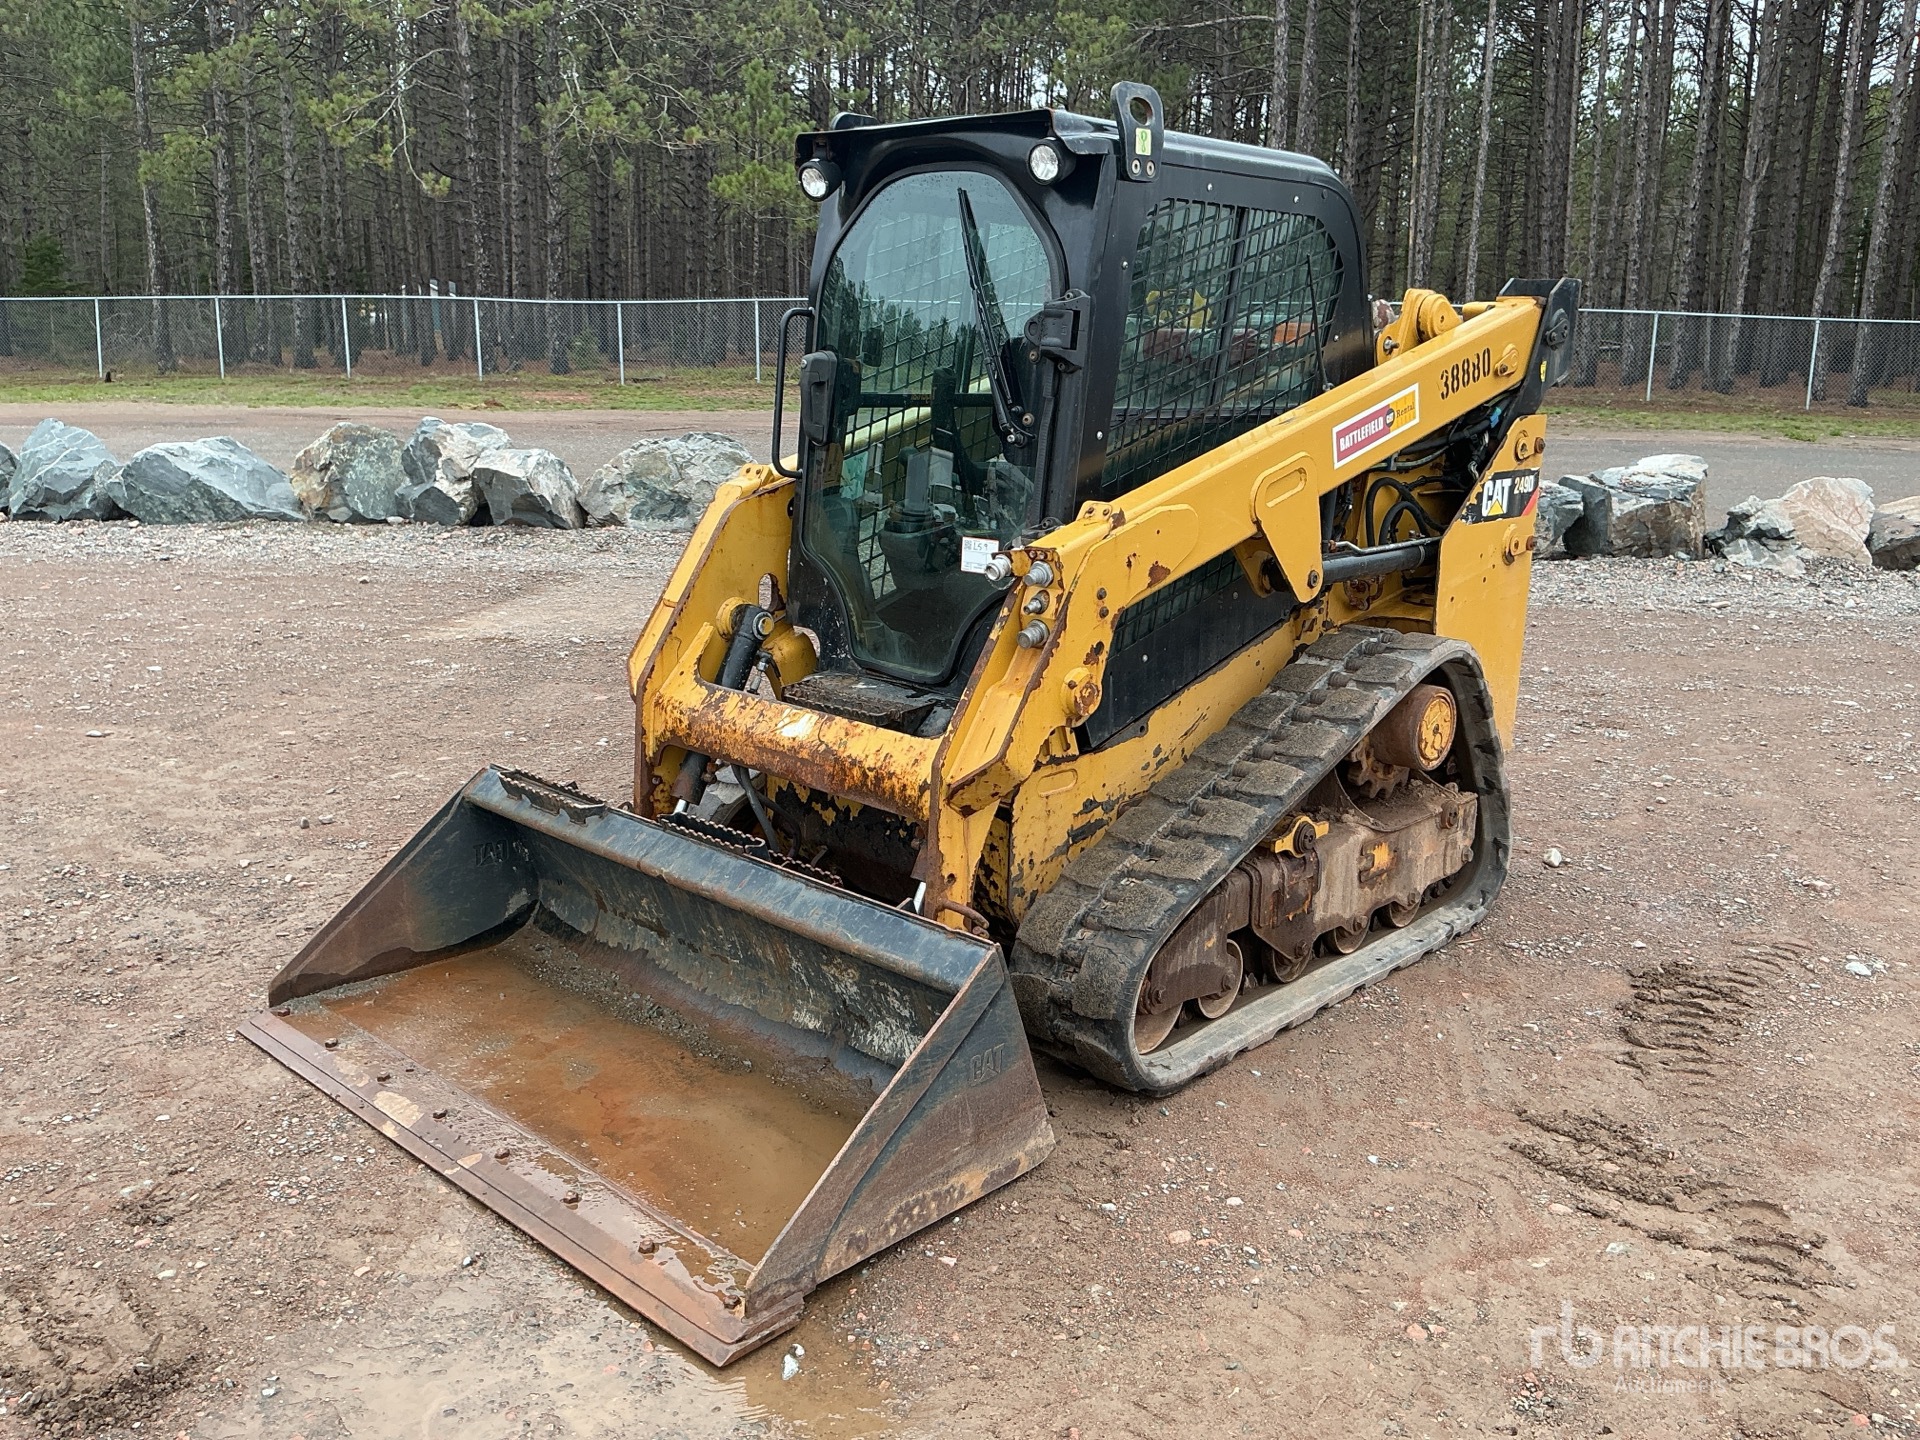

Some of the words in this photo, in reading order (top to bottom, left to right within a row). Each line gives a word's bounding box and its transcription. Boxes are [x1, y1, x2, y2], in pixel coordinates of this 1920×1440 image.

[1440, 347, 1491, 400] 38880
[1339, 416, 1384, 452] BATTLEFIELD
[1396, 402, 1415, 418] Rental
[1481, 478, 1512, 517] CAT
[1513, 474, 1535, 495] 249D
[968, 1042, 1005, 1087] CAT
